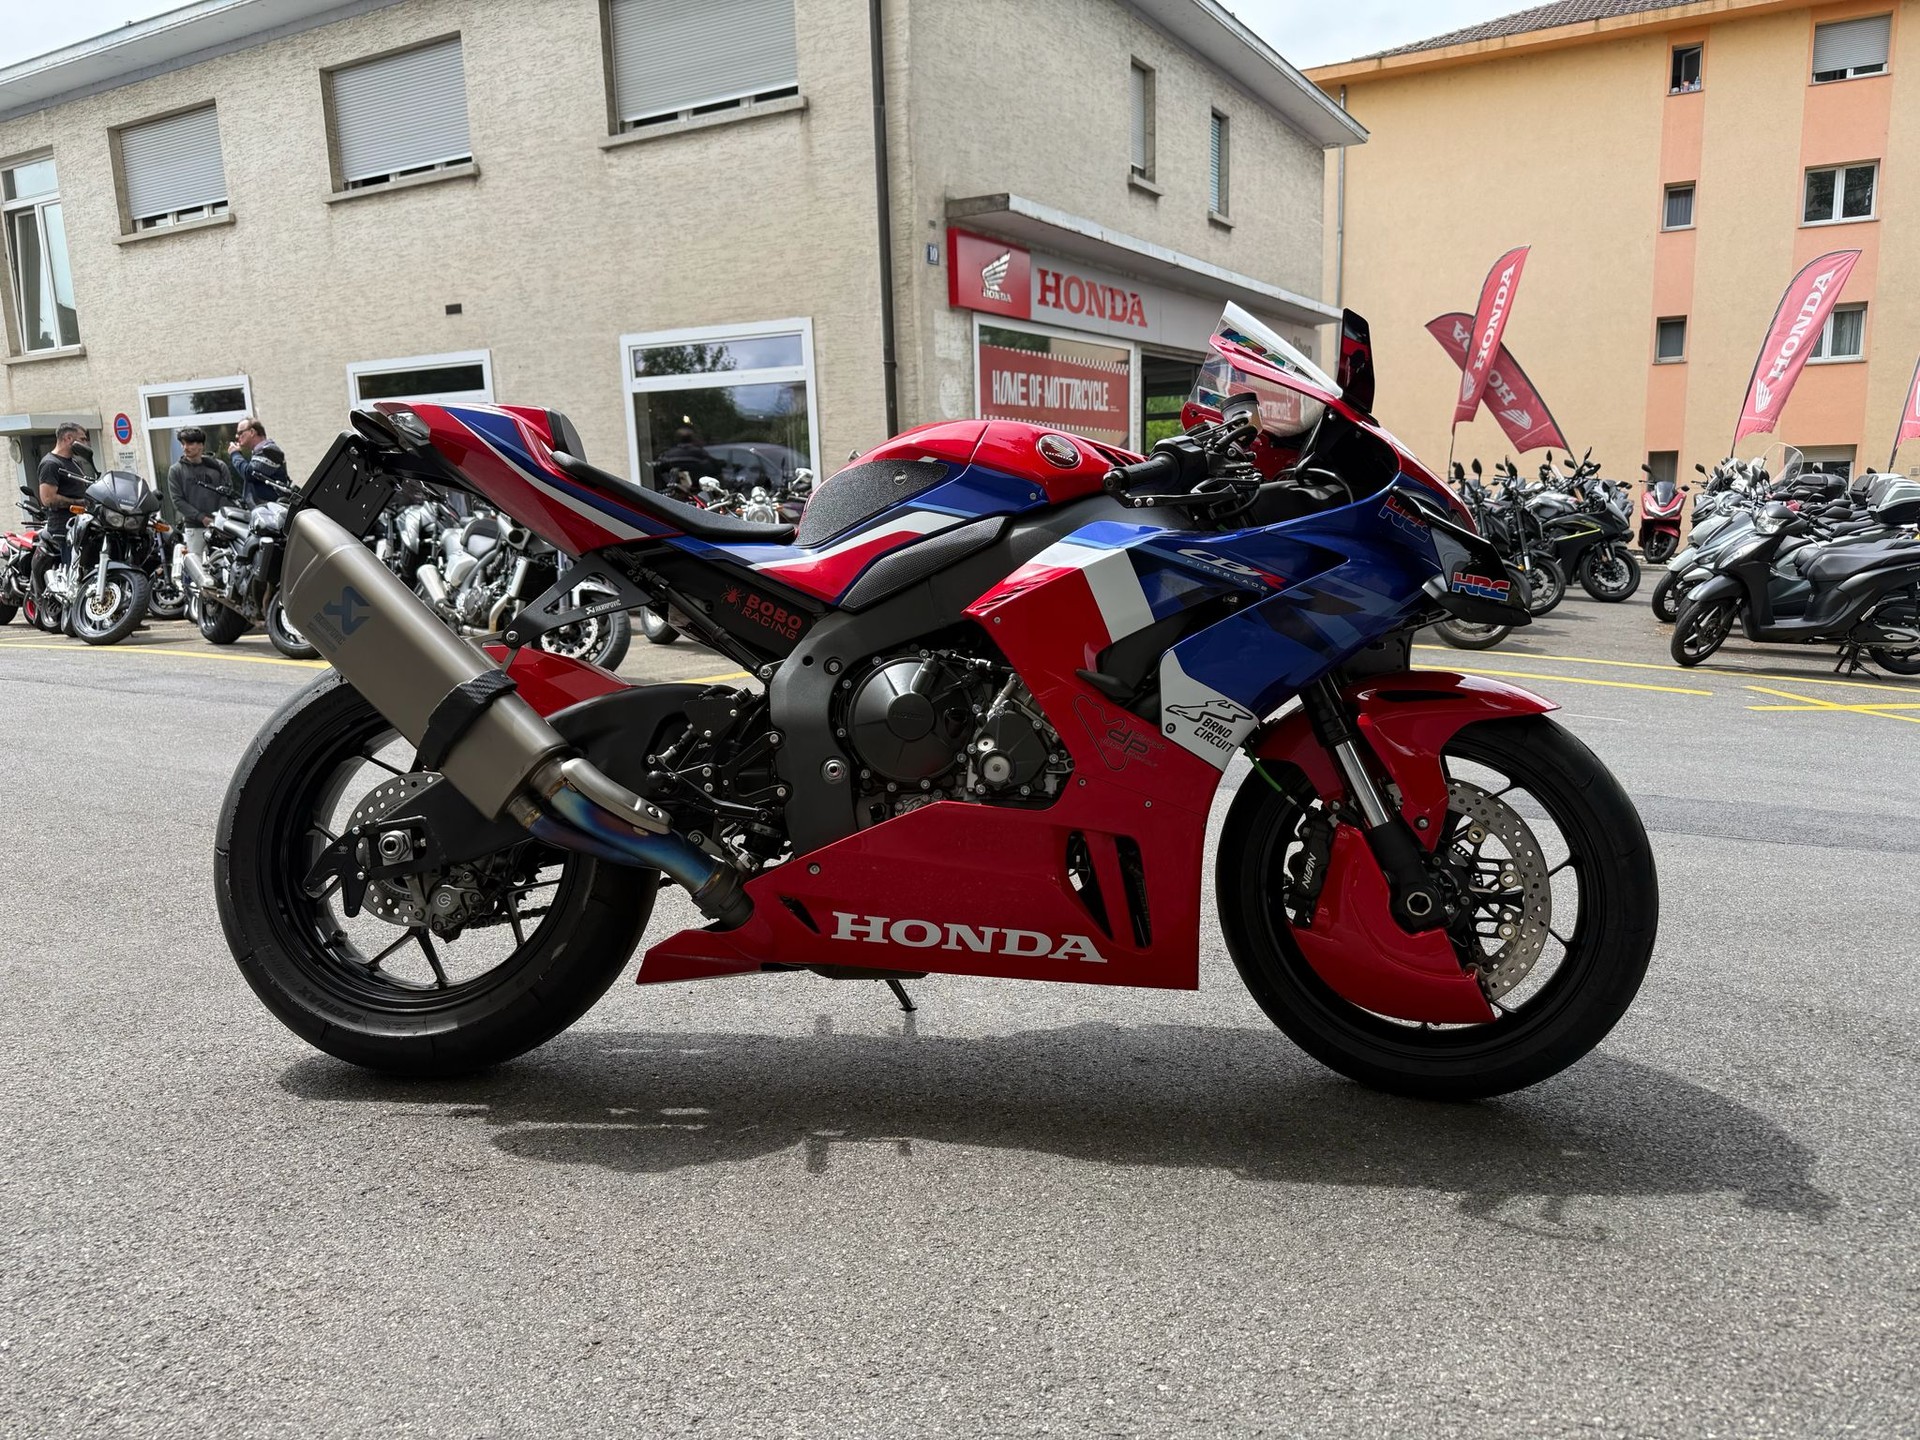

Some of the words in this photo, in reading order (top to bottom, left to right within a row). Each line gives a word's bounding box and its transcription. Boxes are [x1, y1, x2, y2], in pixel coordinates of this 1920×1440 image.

[929, 246, 938, 261] 10
[983, 288, 1012, 303] HONDA
[1037, 267, 1148, 328] HONDA
[1472, 263, 1516, 370] HONDA
[1767, 268, 1835, 380] HONDA
[992, 369, 1027, 406] HOME
[1029, 373, 1042, 407] OF
[1045, 451, 1074, 463] HONDA
[1378, 495, 1431, 543] HRC
[1177, 548, 1287, 590] CBR
[1186, 559, 1268, 591] FIREBLADE
[1452, 572, 1510, 602] HRC
[741, 606, 797, 640] RACING
[746, 594, 802, 630] BOBO
[1193, 727, 1235, 753] CIRCUIT
[1201, 717, 1233, 739] BRNO
[1302, 852, 1317, 889] NISSIN
[831, 911, 1108, 964] HONDA
